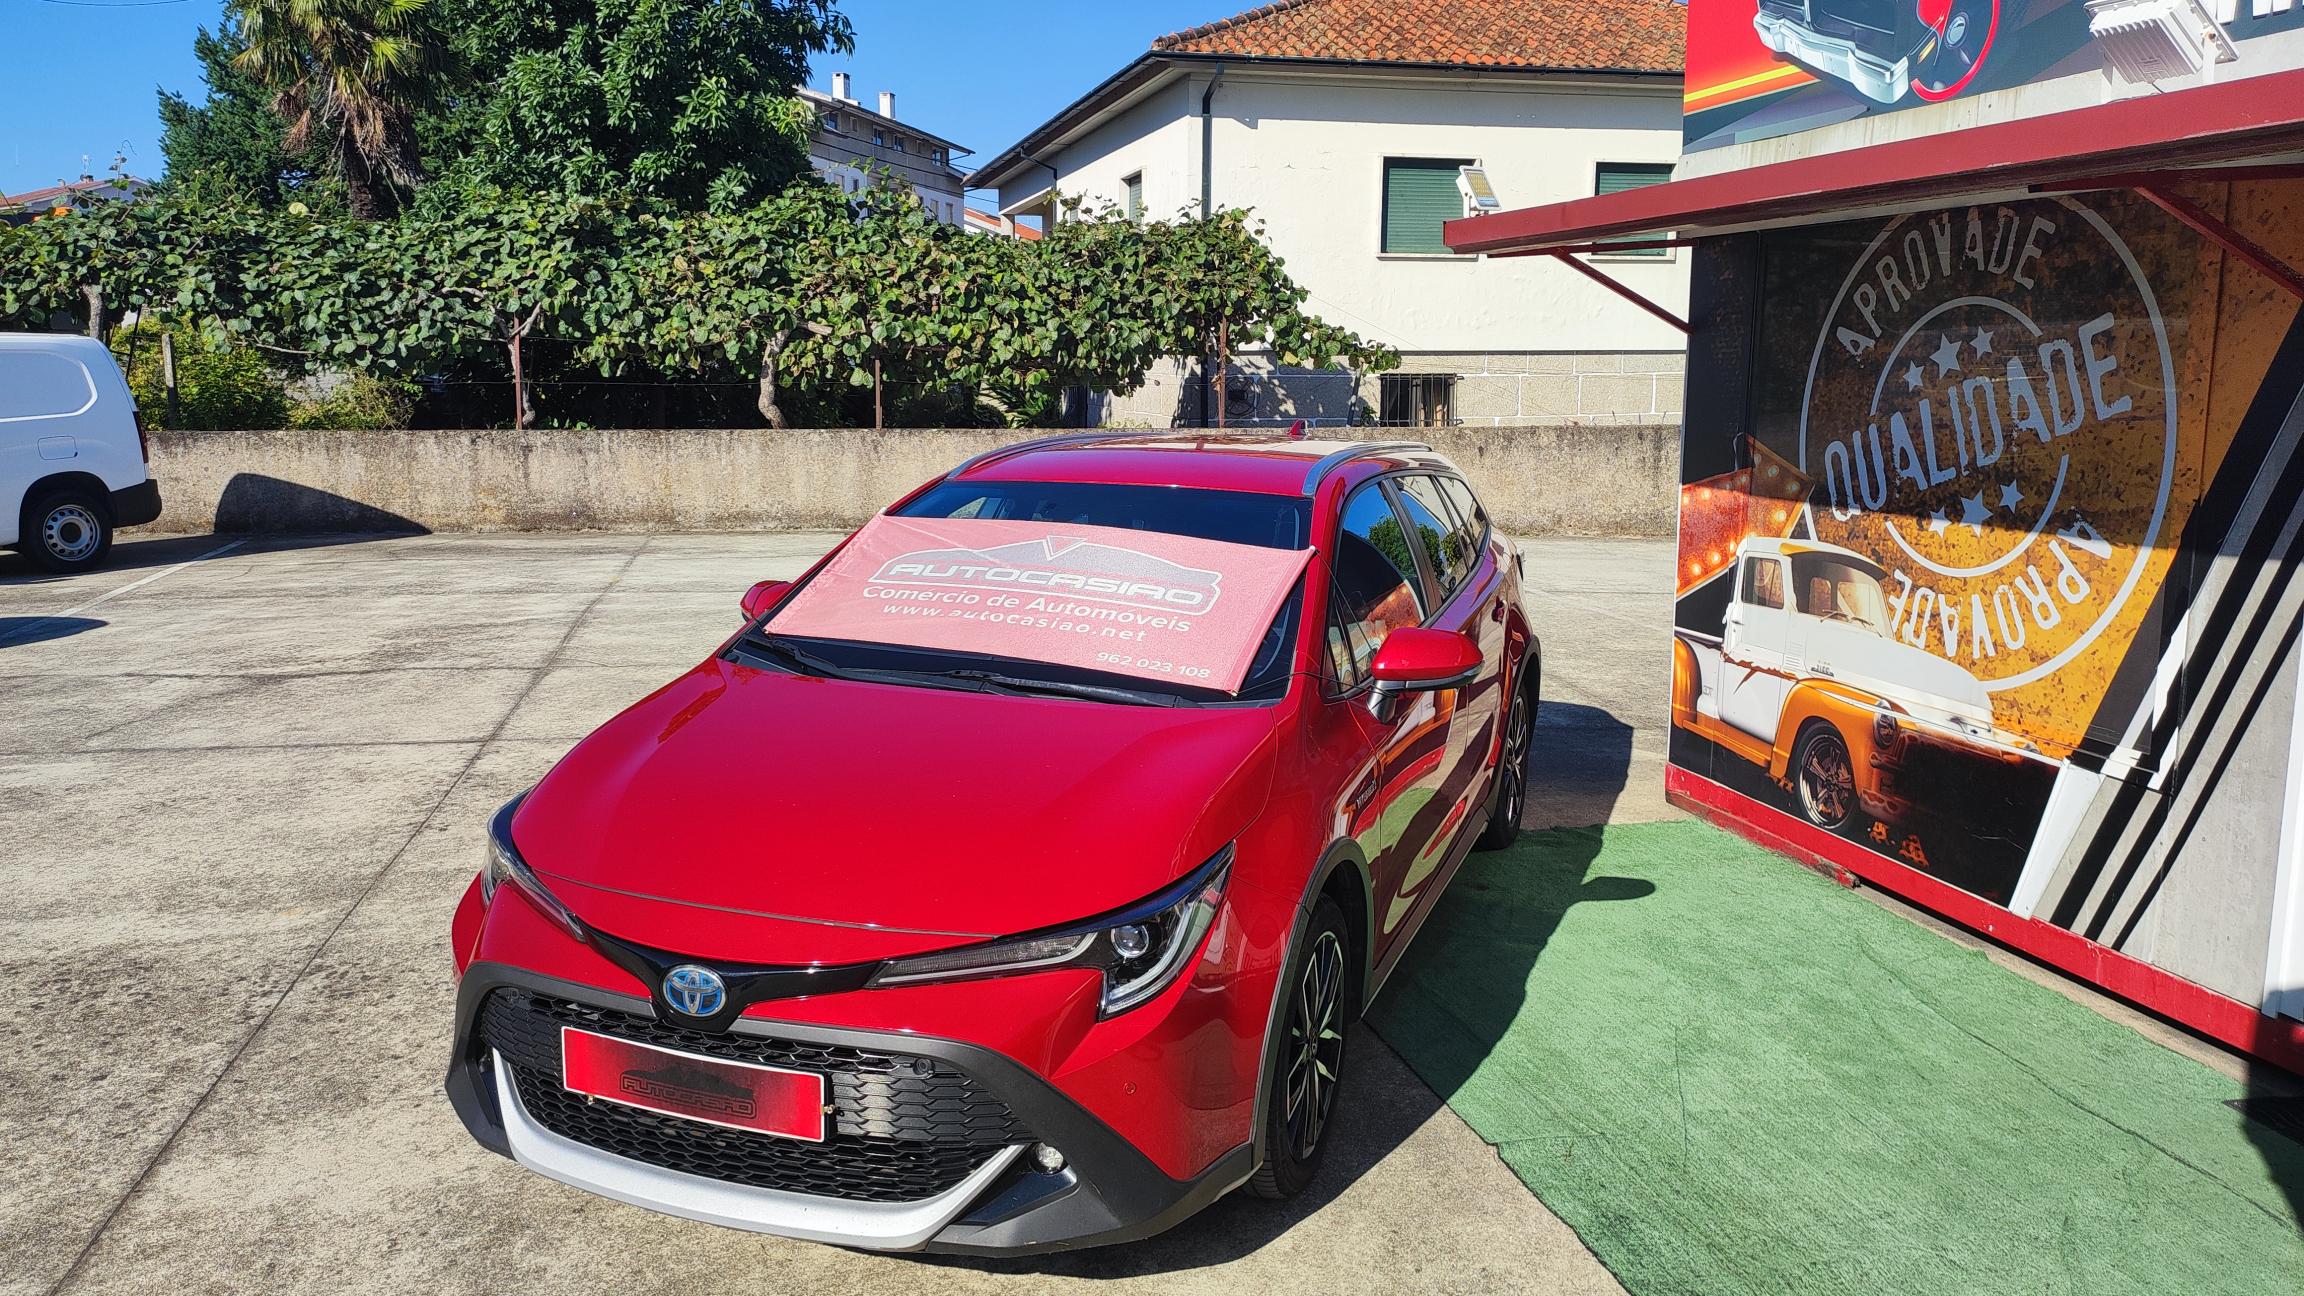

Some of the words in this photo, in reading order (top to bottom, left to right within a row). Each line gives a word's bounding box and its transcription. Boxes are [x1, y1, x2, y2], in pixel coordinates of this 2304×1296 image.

[1836, 206, 2056, 368] APROVADE
[1824, 312, 2132, 521] QUALIDADE
[889, 563, 1203, 604] AUTOCASIAO
[863, 586, 980, 604] Comércio
[986, 594, 1020, 608] de
[1025, 597, 1191, 632] Automóveis
[883, 604, 1147, 641] www.autocasiao.net
[1097, 652, 1132, 665] 962
[1136, 658, 1173, 672] 023
[1179, 665, 1211, 678] 108
